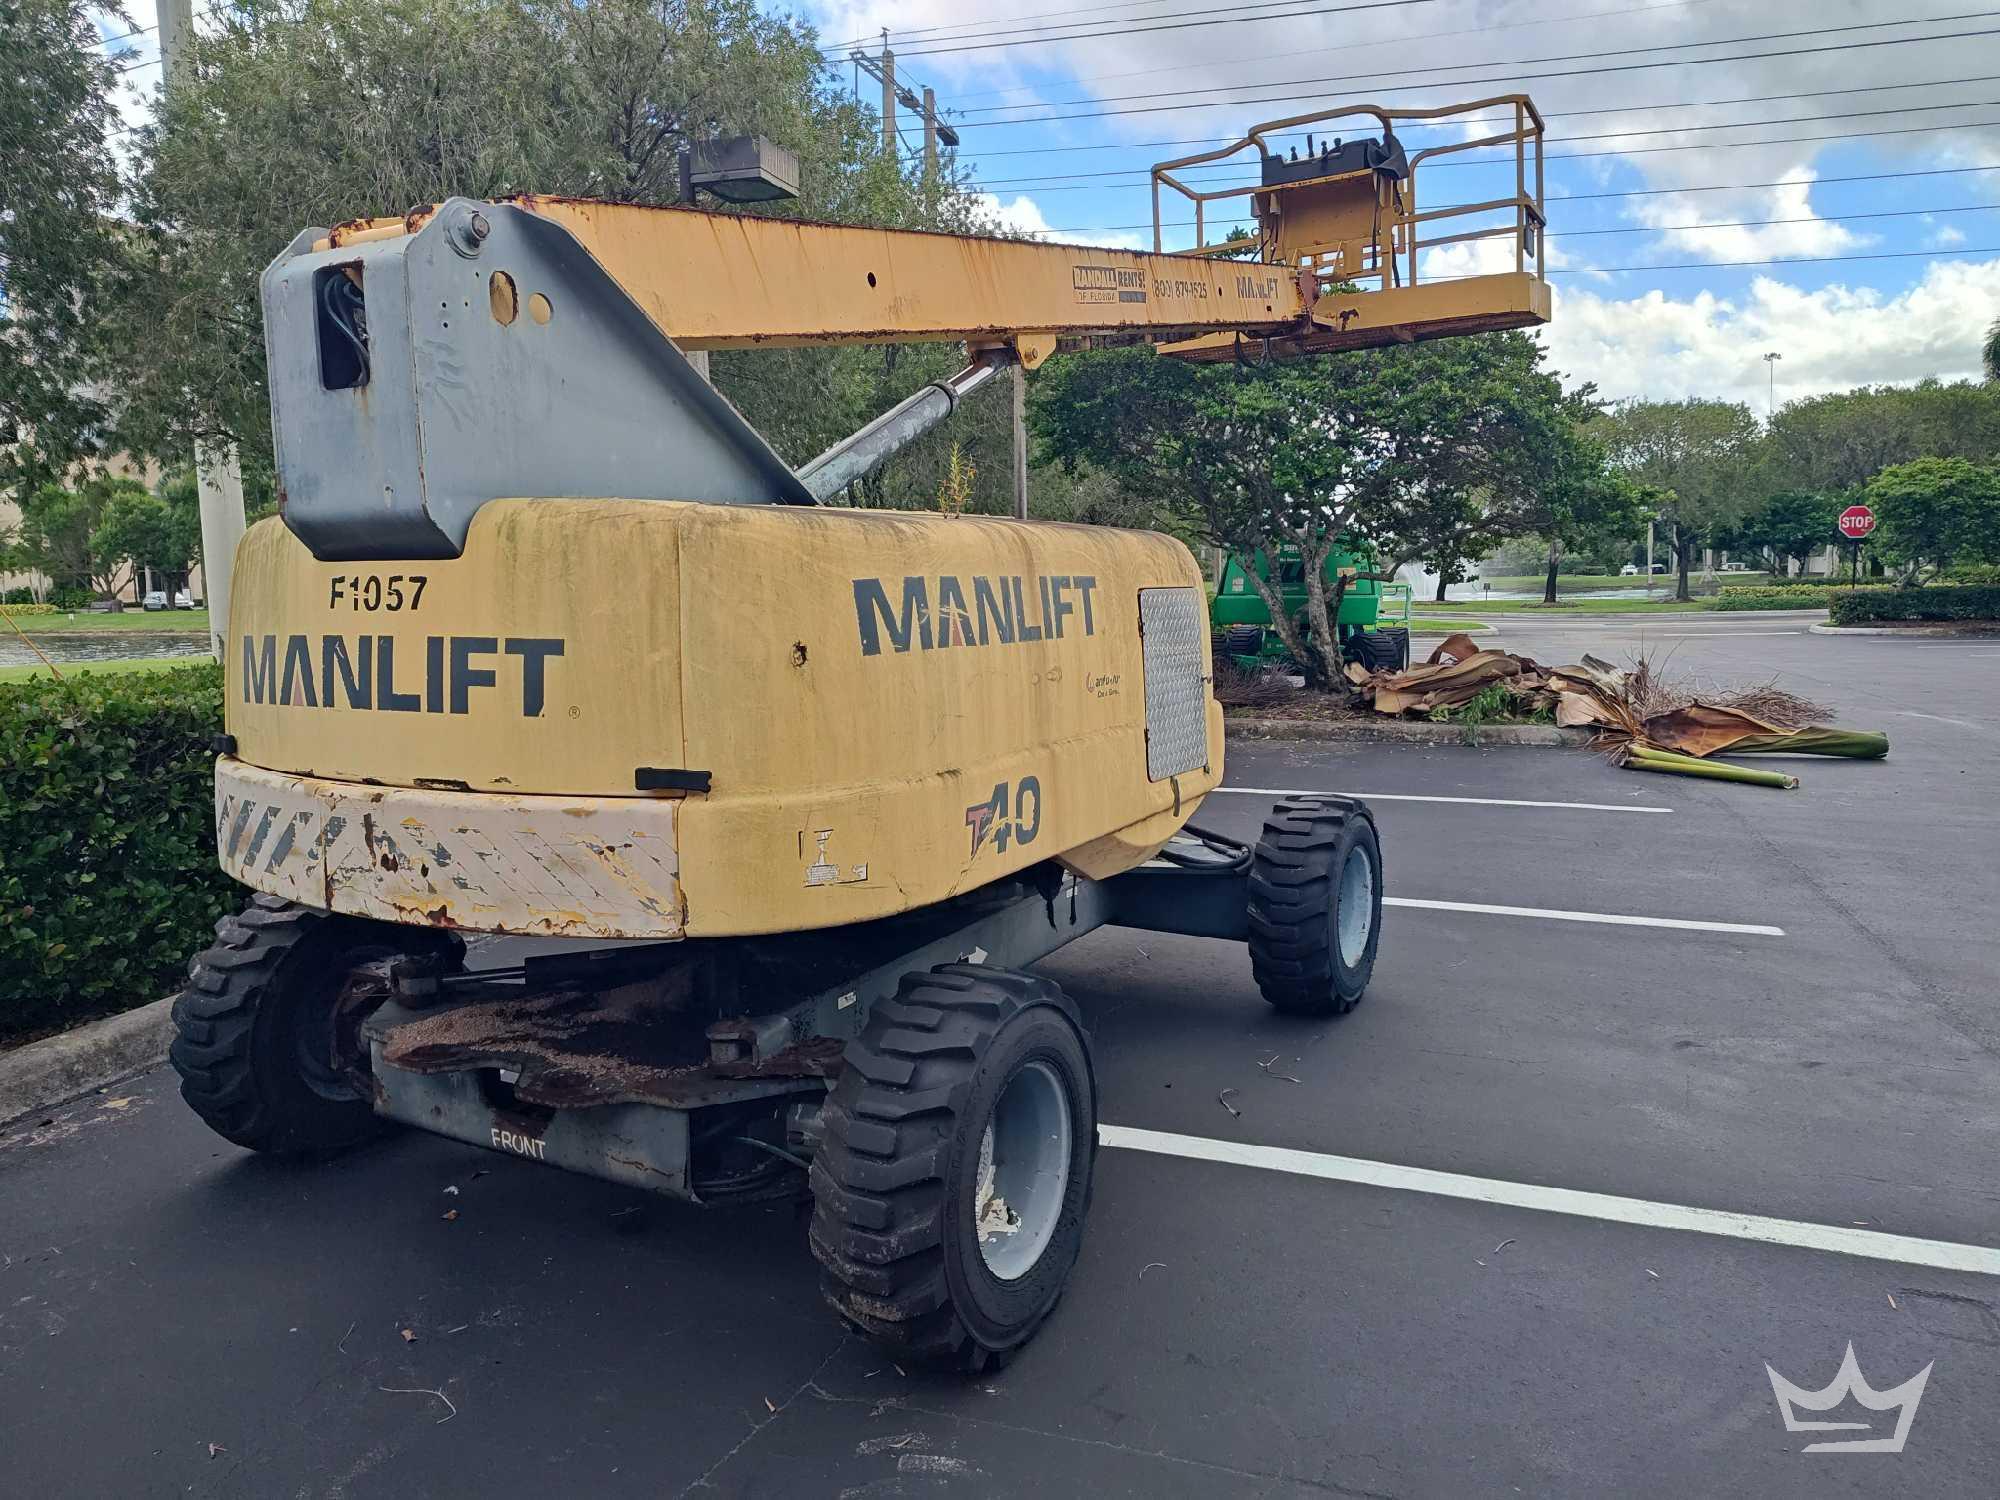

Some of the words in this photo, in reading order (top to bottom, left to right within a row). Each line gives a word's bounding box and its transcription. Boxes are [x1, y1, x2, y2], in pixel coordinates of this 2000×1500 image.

[1117, 270, 1146, 288] RENTS!
[1842, 516, 1873, 528] STOP
[329, 575, 428, 612] F1057
[852, 575, 1097, 656] MANLIFT
[242, 634, 565, 717] MANLIFT
[491, 1128, 546, 1160] FRONT
